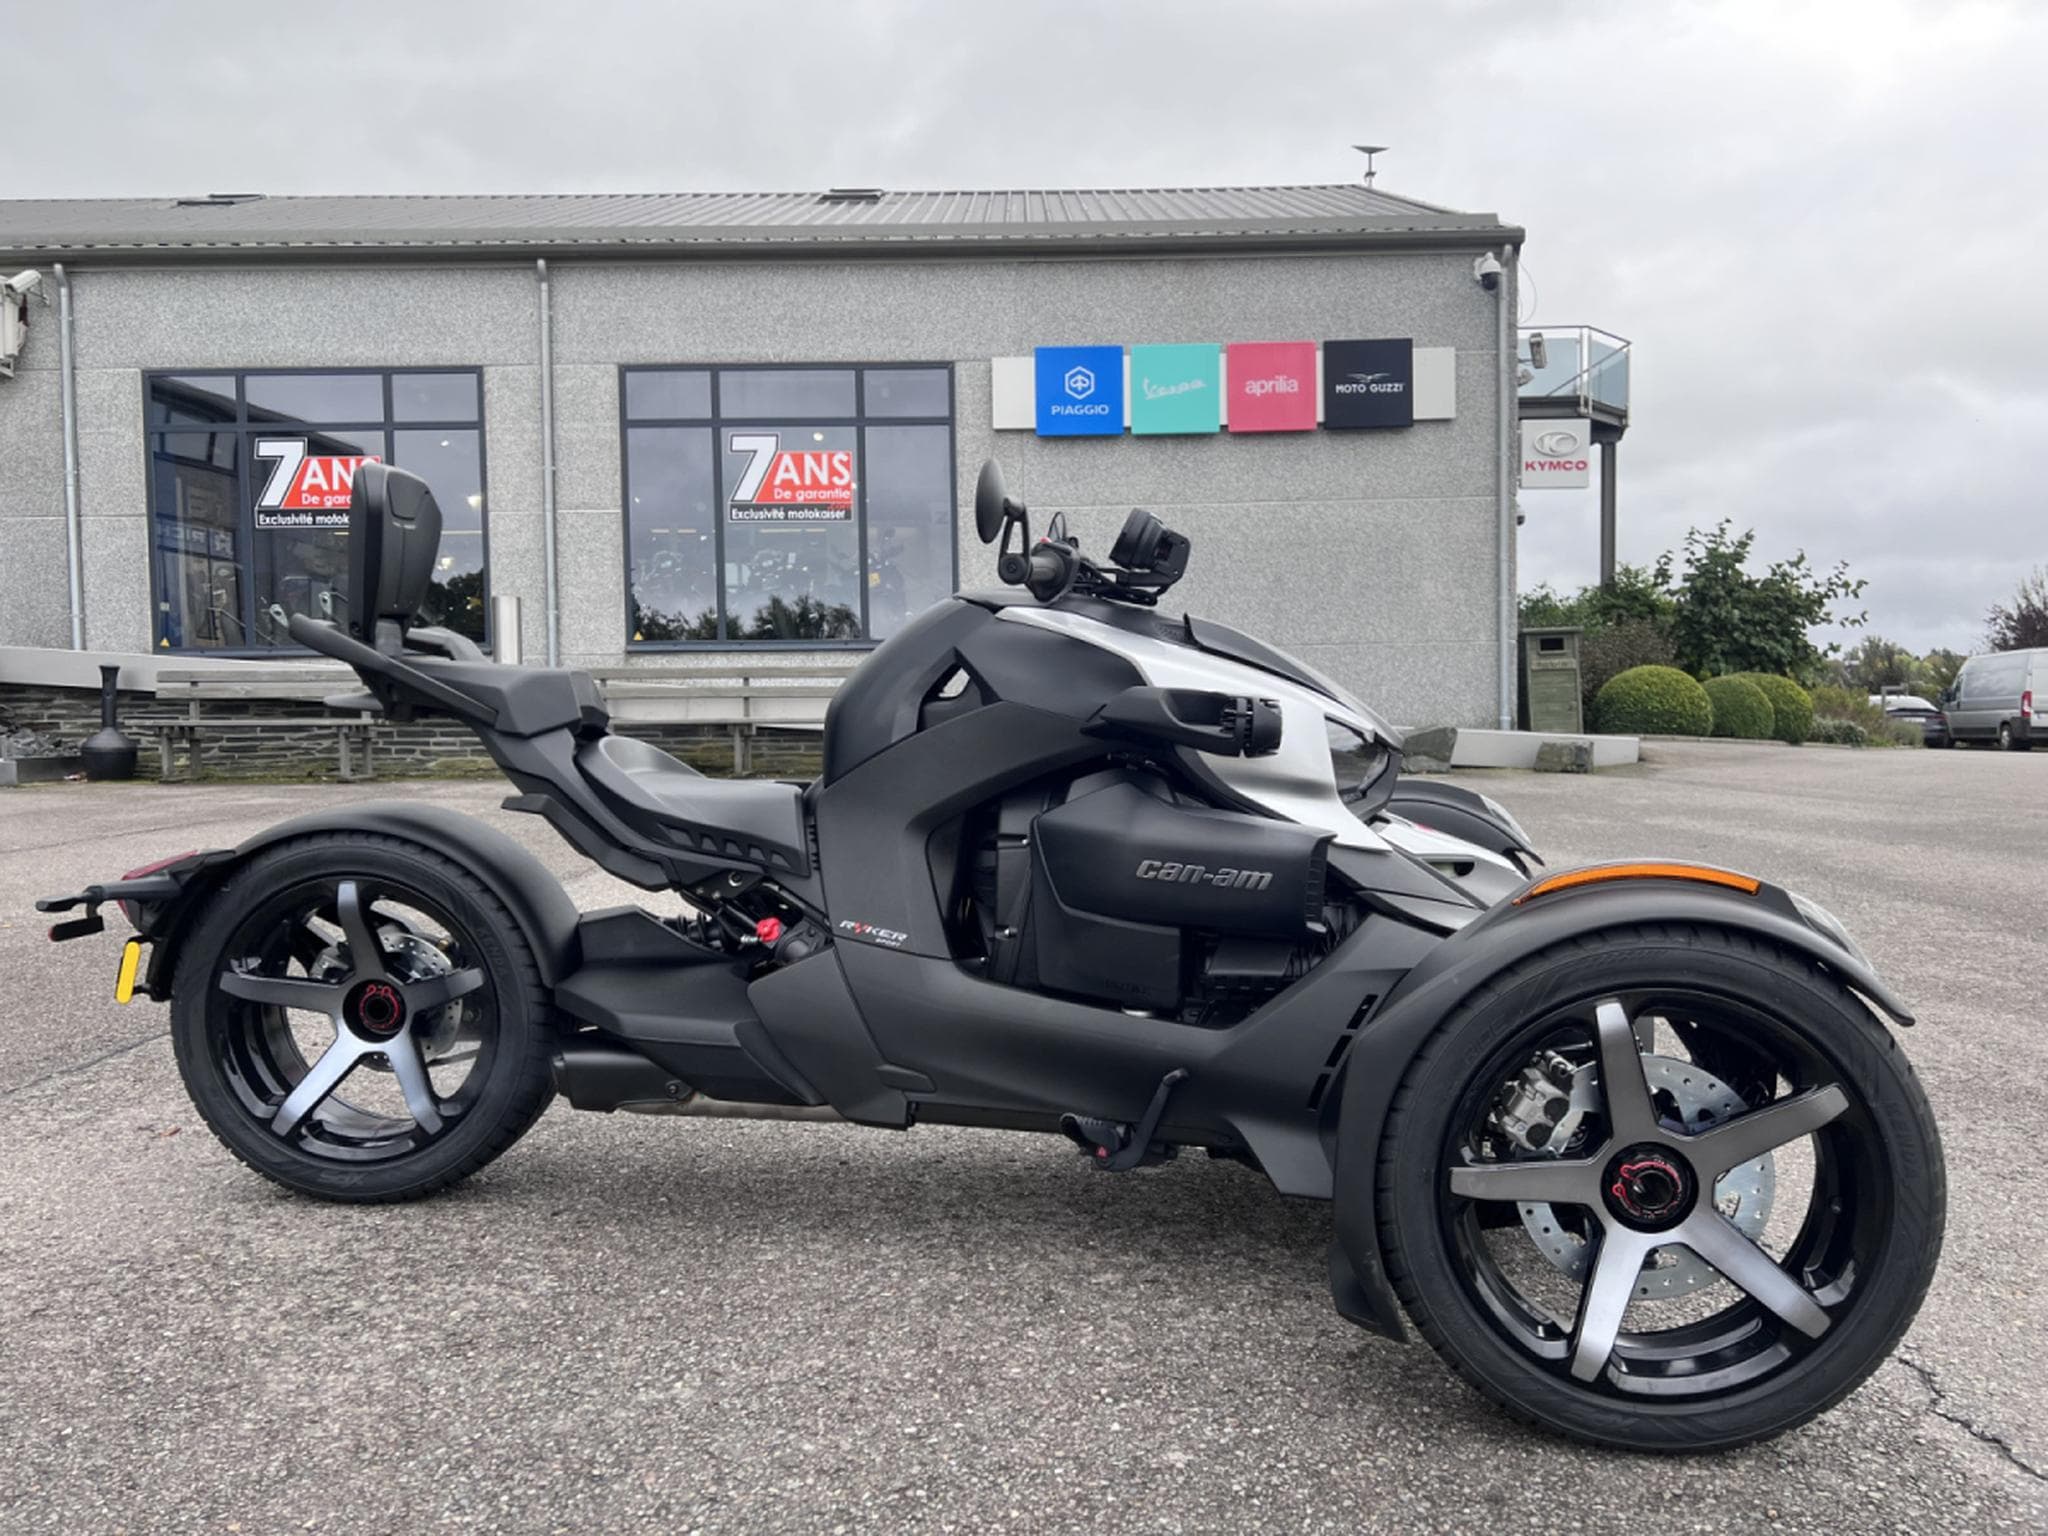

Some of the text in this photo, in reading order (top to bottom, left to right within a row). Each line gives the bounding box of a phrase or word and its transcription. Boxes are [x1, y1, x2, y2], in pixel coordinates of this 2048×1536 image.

[1142, 377, 1207, 400] Vespa
[1245, 375, 1299, 397] aprilia
[1335, 382, 1404, 394] MOTO GUZZI
[1051, 404, 1109, 416] PIAGGIO
[256, 438, 307, 508] 7
[730, 434, 850, 502] 7 ANS
[1524, 460, 1588, 471] KYMCO
[301, 492, 320, 504] De
[774, 487, 851, 502] De garantie
[258, 513, 350, 525] Exclusivité motok
[731, 506, 846, 520] Exclusivité motokaiser
[1136, 859, 1273, 891] can-am
[839, 919, 908, 942] RYKER
